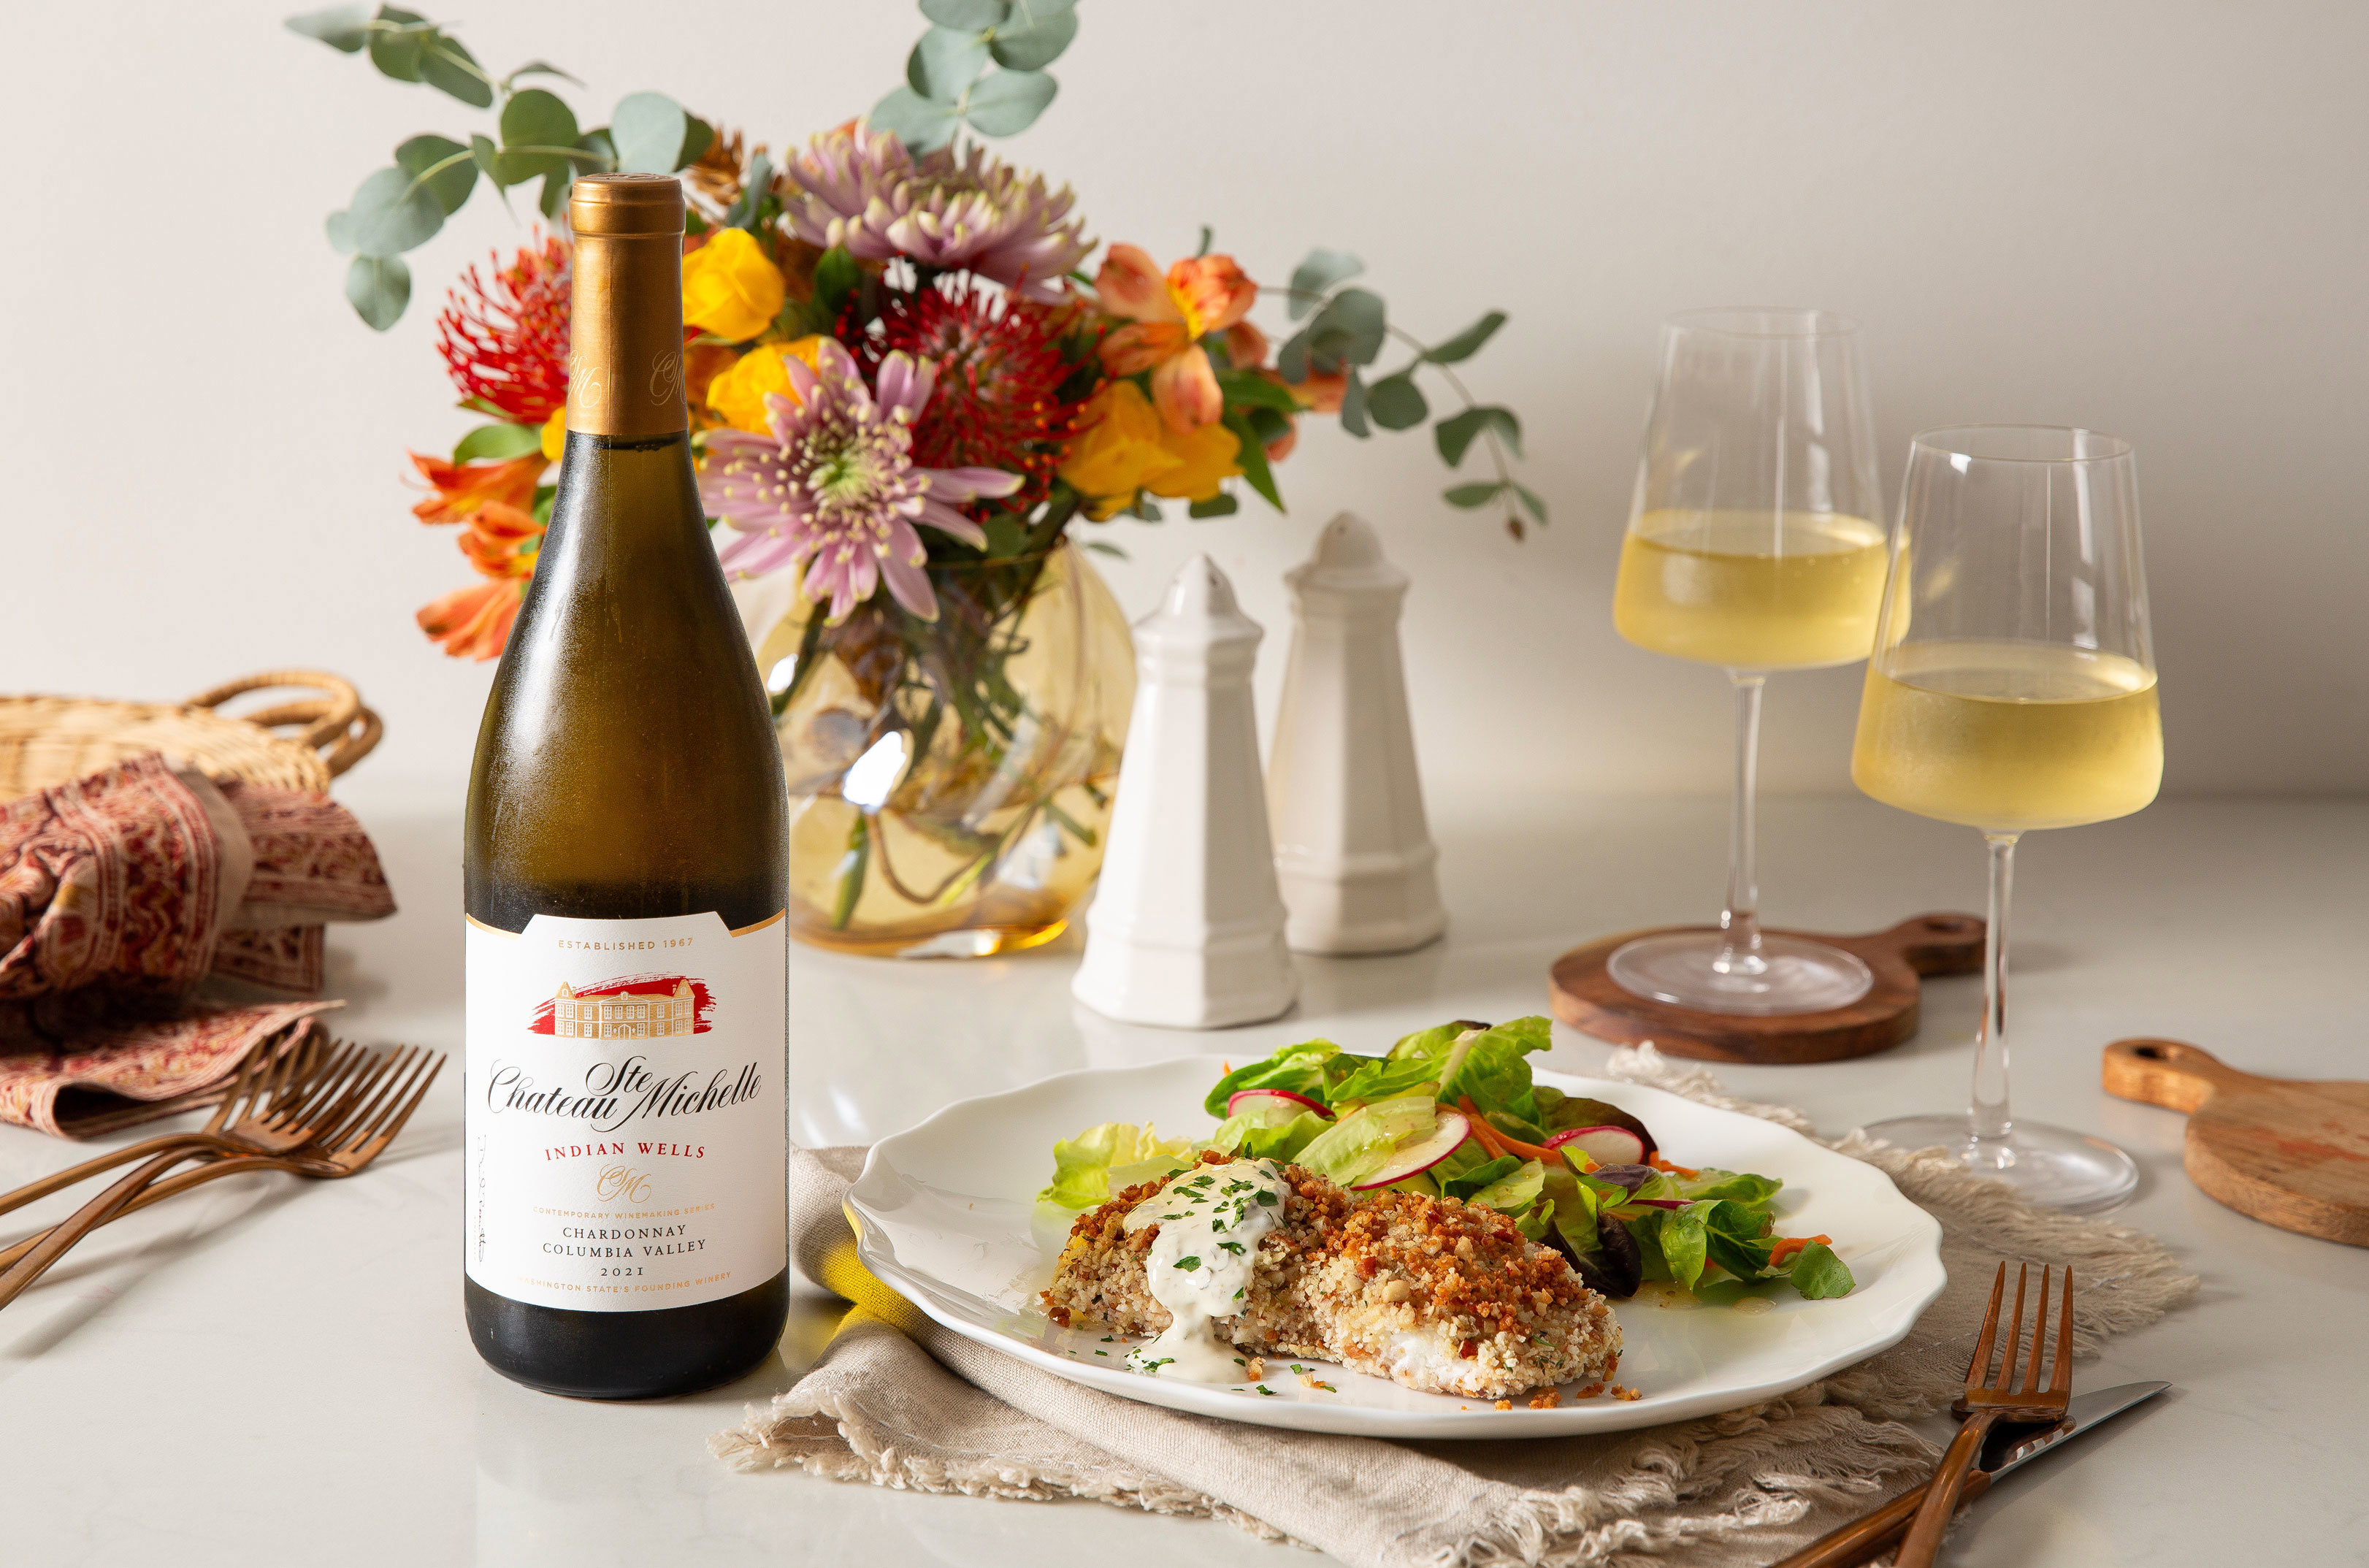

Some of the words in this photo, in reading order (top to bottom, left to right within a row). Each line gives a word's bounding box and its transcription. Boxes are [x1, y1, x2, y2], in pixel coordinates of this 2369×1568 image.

[559, 940, 655, 950] ESTABLISHED
[663, 938, 694, 948] 1967
[585, 1055, 654, 1096] Ste
[488, 1058, 619, 1120] Chateau
[590, 1062, 762, 1133] Michelle
[545, 1142, 624, 1161] INDIAN
[638, 1142, 705, 1158] WELLS
[533, 1206, 610, 1219] CONTEMPORARY
[615, 1209, 680, 1219] WINEMAKING
[684, 1203, 715, 1215] SERIES
[563, 1224, 686, 1240] CHARDONNAY
[543, 1242, 633, 1258] COLUMBIA
[643, 1239, 705, 1256] VALLEY
[600, 1267, 643, 1277] 2021
[586, 1285, 629, 1293] STATE'S
[635, 1280, 690, 1292] FOUNDING
[695, 1271, 731, 1285] WINERY
